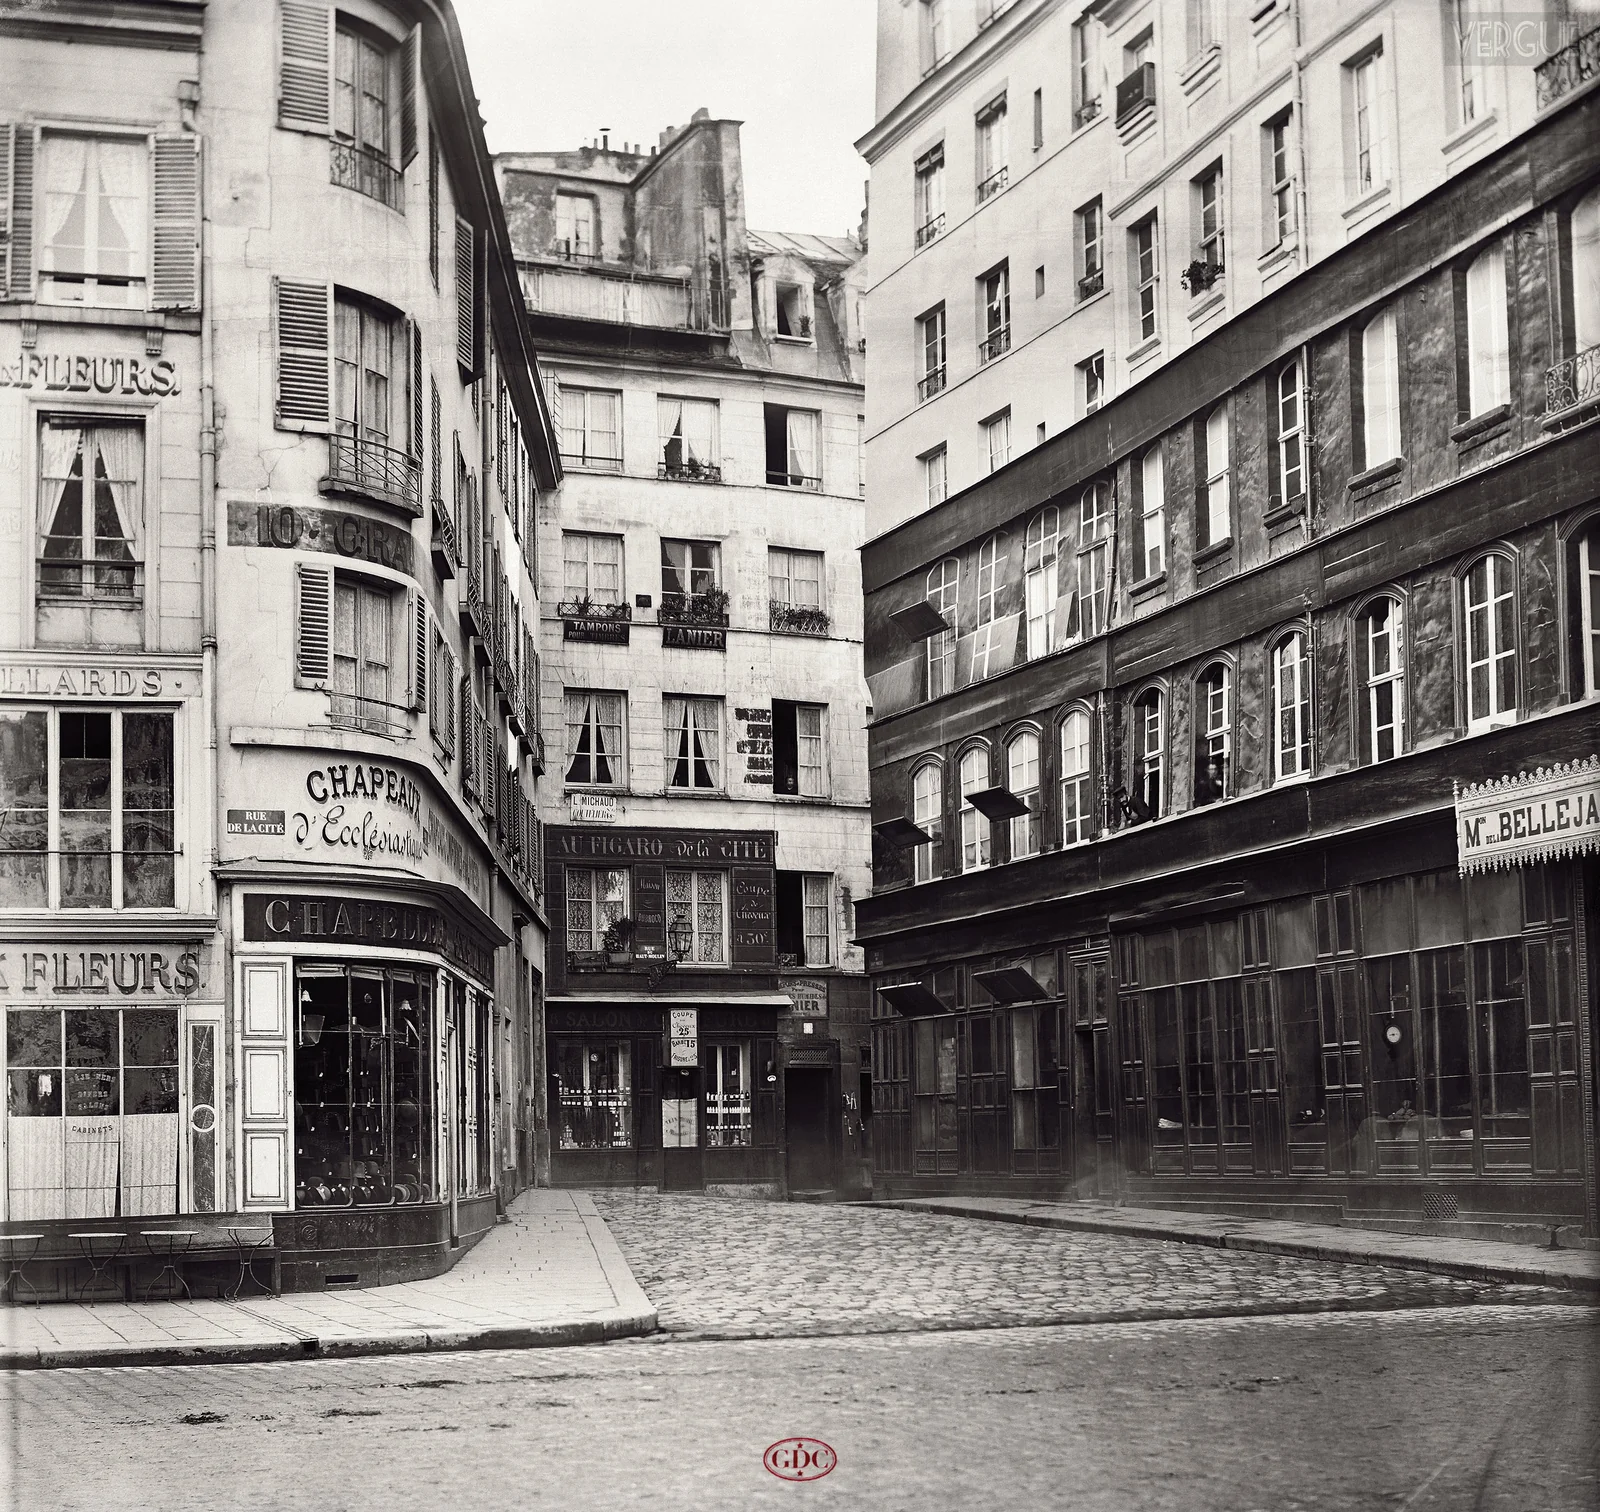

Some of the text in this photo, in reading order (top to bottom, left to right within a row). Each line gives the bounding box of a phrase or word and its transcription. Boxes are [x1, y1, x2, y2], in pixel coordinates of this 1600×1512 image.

[254, 505, 304, 549] 10
[573, 621, 621, 634] TAMPONS
[568, 631, 586, 639] POUR
[665, 628, 724, 648] LANIER
[306, 764, 421, 825] CHAPEAUX
[581, 796, 614, 807] MICHAUD
[245, 811, 267, 821] RUE
[1498, 798, 1571, 842] BELLE
[227, 821, 285, 834] DE LA CITÉ
[556, 836, 584, 854] AU
[590, 836, 663, 856] FIGARO
[720, 838, 766, 858] CITÉ
[672, 1011, 694, 1019] COUPE
[678, 1027, 690, 1036] 25
[686, 1039, 696, 1049] 15
[71, 1124, 113, 1134] CABINETS
